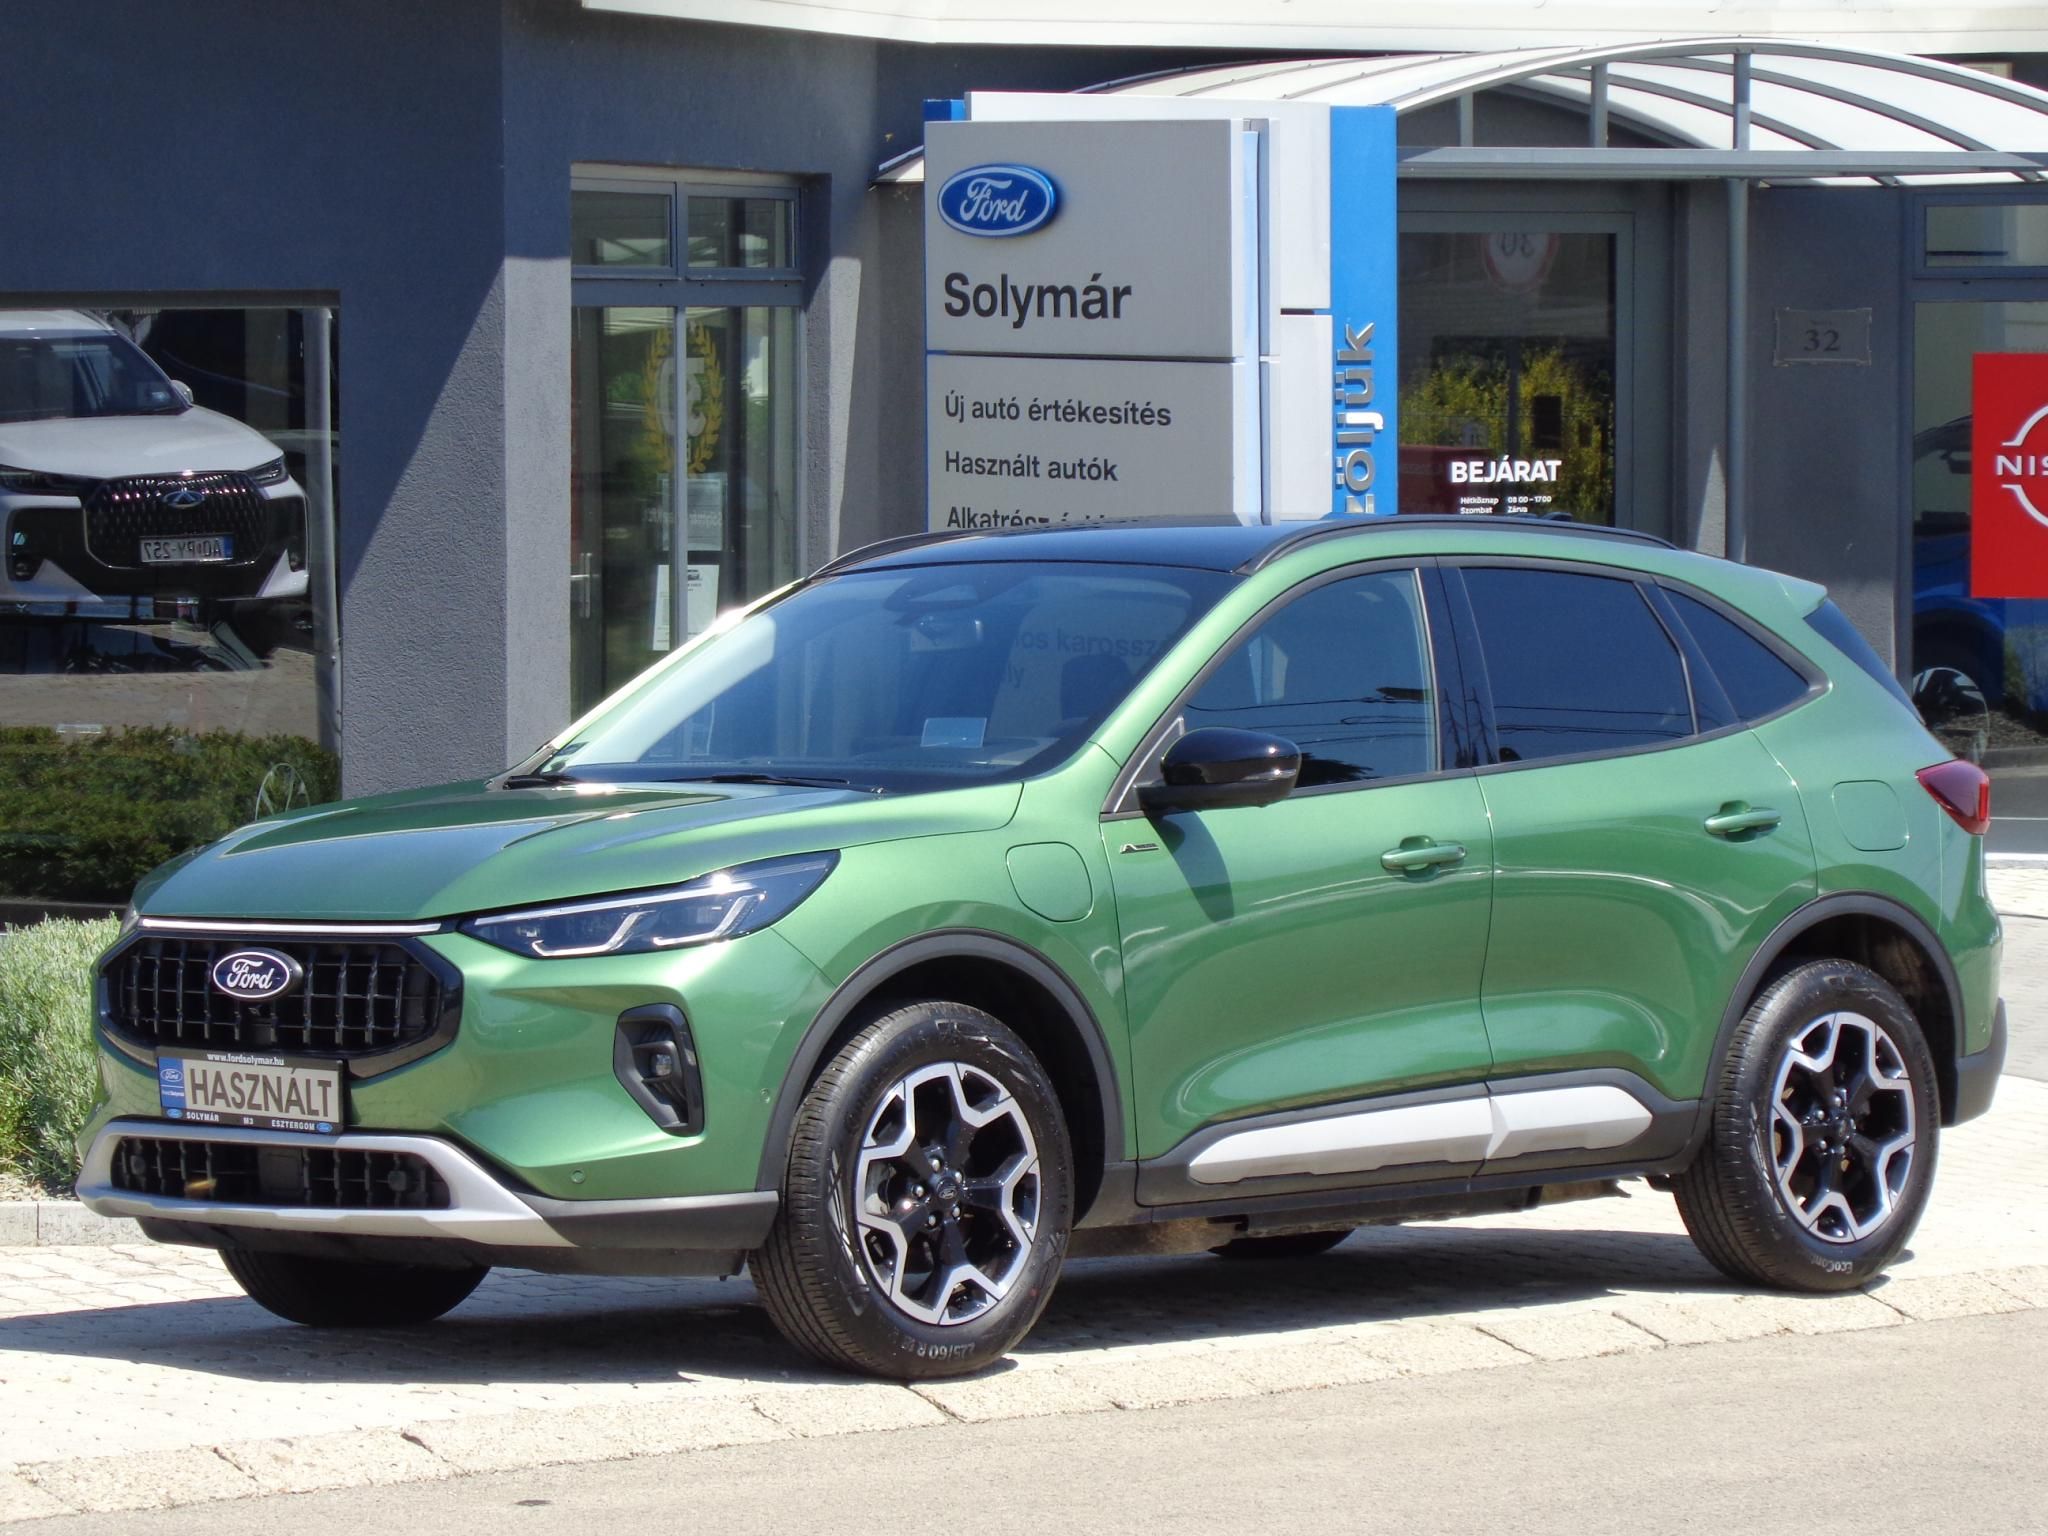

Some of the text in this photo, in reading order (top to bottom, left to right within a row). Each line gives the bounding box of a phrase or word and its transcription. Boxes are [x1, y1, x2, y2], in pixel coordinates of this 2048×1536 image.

[960, 177, 1029, 223] Ford
[944, 271, 1132, 329] Solymár
[1804, 329, 1839, 352] 32
[945, 390, 1172, 426] Új autó értékesítés
[945, 450, 1119, 482] Használt autók
[1451, 454, 1562, 483] BEJÁRAT
[1056, 627, 1157, 657] karossz
[226, 958, 275, 990] Ford
[206, 1052, 285, 1067] www.fordsolymar.hu
[190, 1067, 332, 1118] HASZNÁLT
[186, 1111, 220, 1122] SOLYMÁR
[271, 1119, 315, 1131] ESZTERGOM
